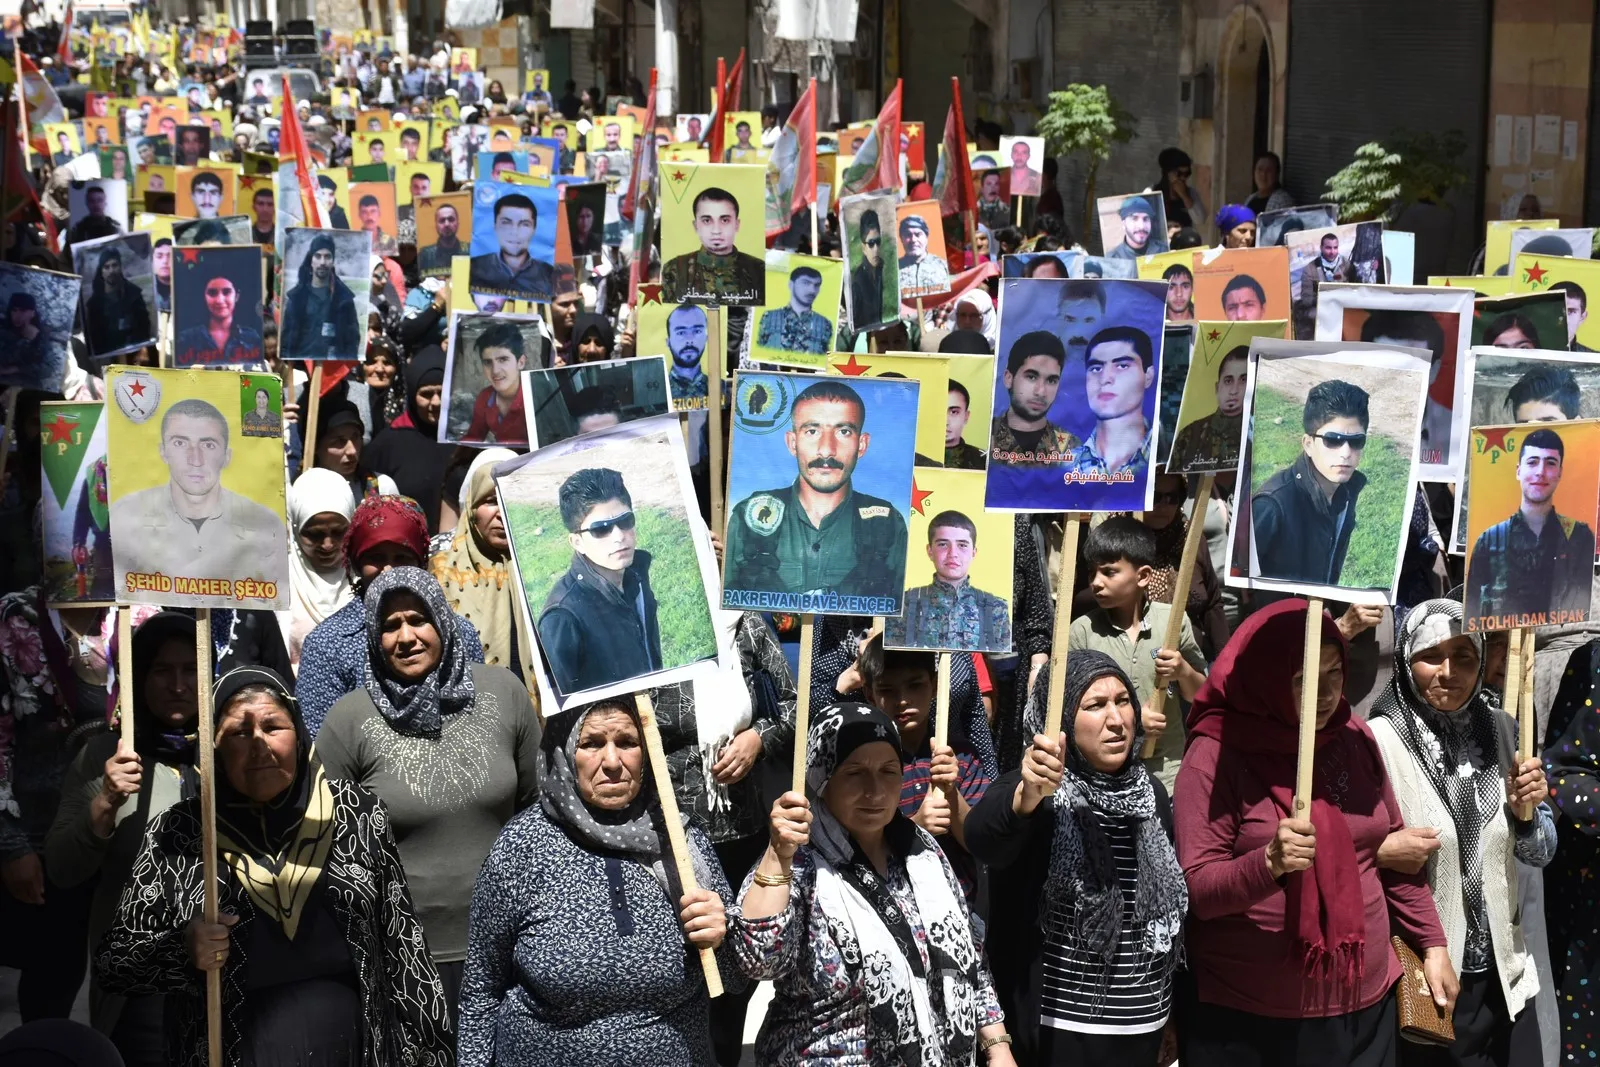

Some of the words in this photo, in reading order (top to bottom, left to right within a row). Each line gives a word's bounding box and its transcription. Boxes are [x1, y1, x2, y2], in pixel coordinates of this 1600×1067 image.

[721, 288, 758, 304] الشهيد
[673, 396, 701, 411] EZLOM
[125, 572, 172, 593] ŞEHÎD
[175, 577, 232, 596] MAHER
[234, 578, 278, 600] ŞÊXO
[722, 589, 800, 609] PAKREWAN
[801, 592, 838, 611] BAVÊ
[838, 597, 896, 615] XENÇER
